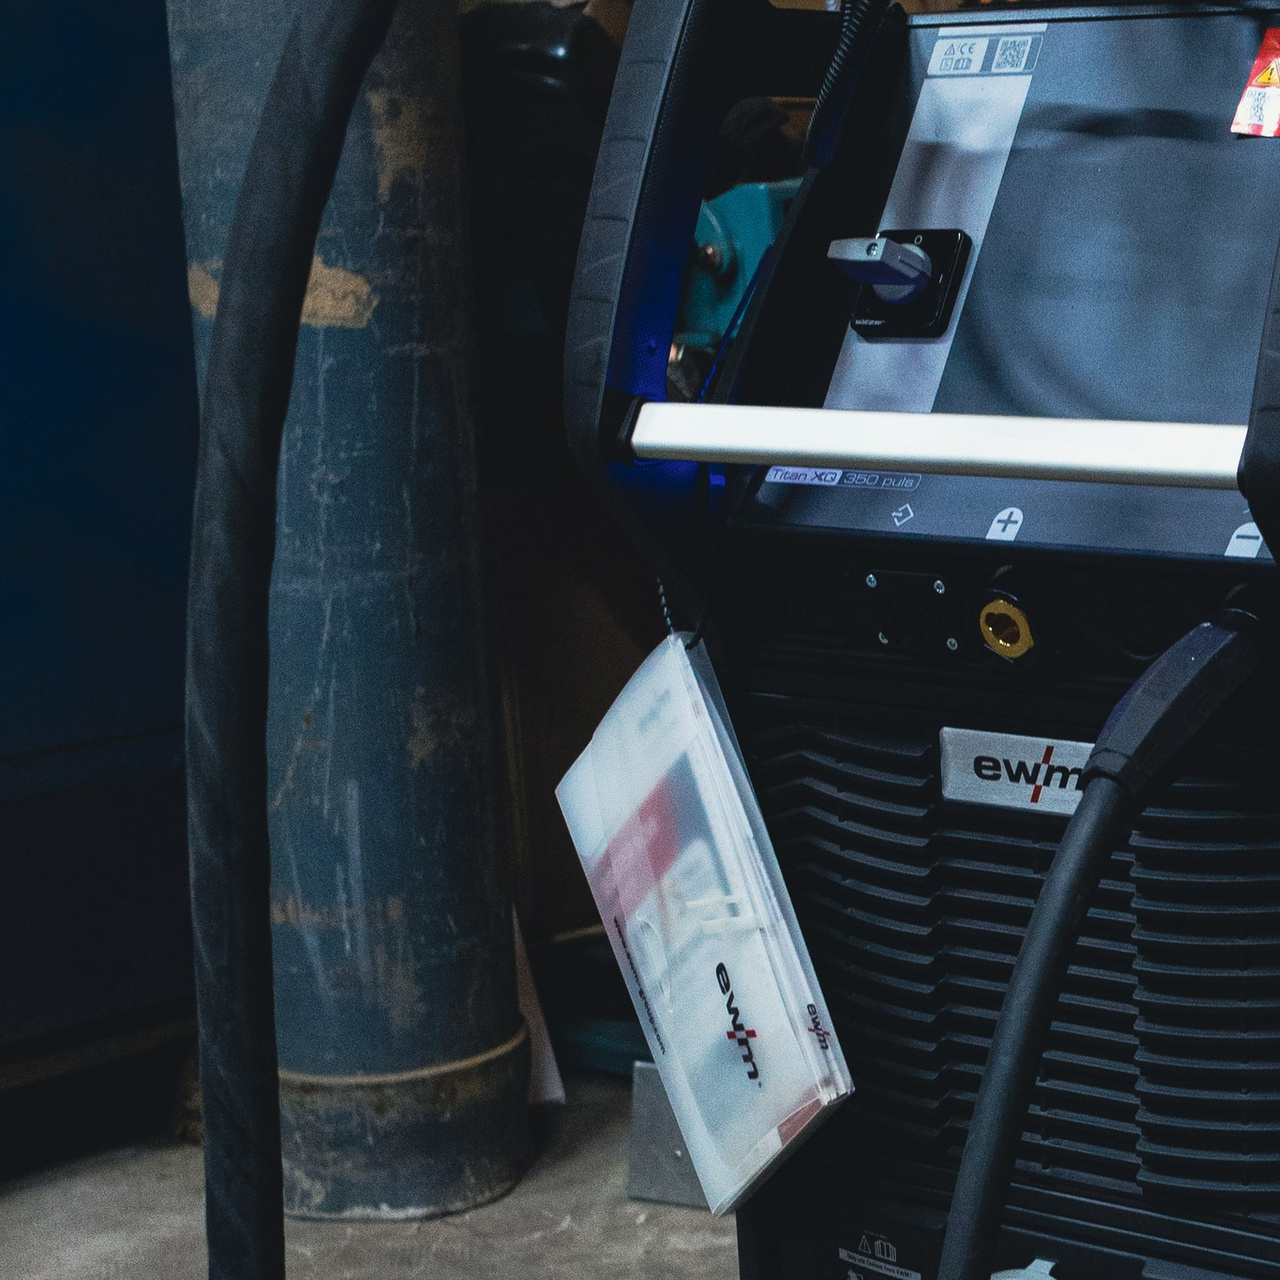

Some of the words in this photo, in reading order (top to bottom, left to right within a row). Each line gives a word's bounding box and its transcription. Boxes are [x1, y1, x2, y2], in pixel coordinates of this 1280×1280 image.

[772, 468, 807, 481] Titan
[811, 472, 837, 482] XQ
[843, 474, 879, 485] 350
[881, 476, 914, 488] puls
[973, 745, 1084, 803] ewm
[716, 962, 758, 1079] ewm
[807, 1003, 830, 1050] ewm
